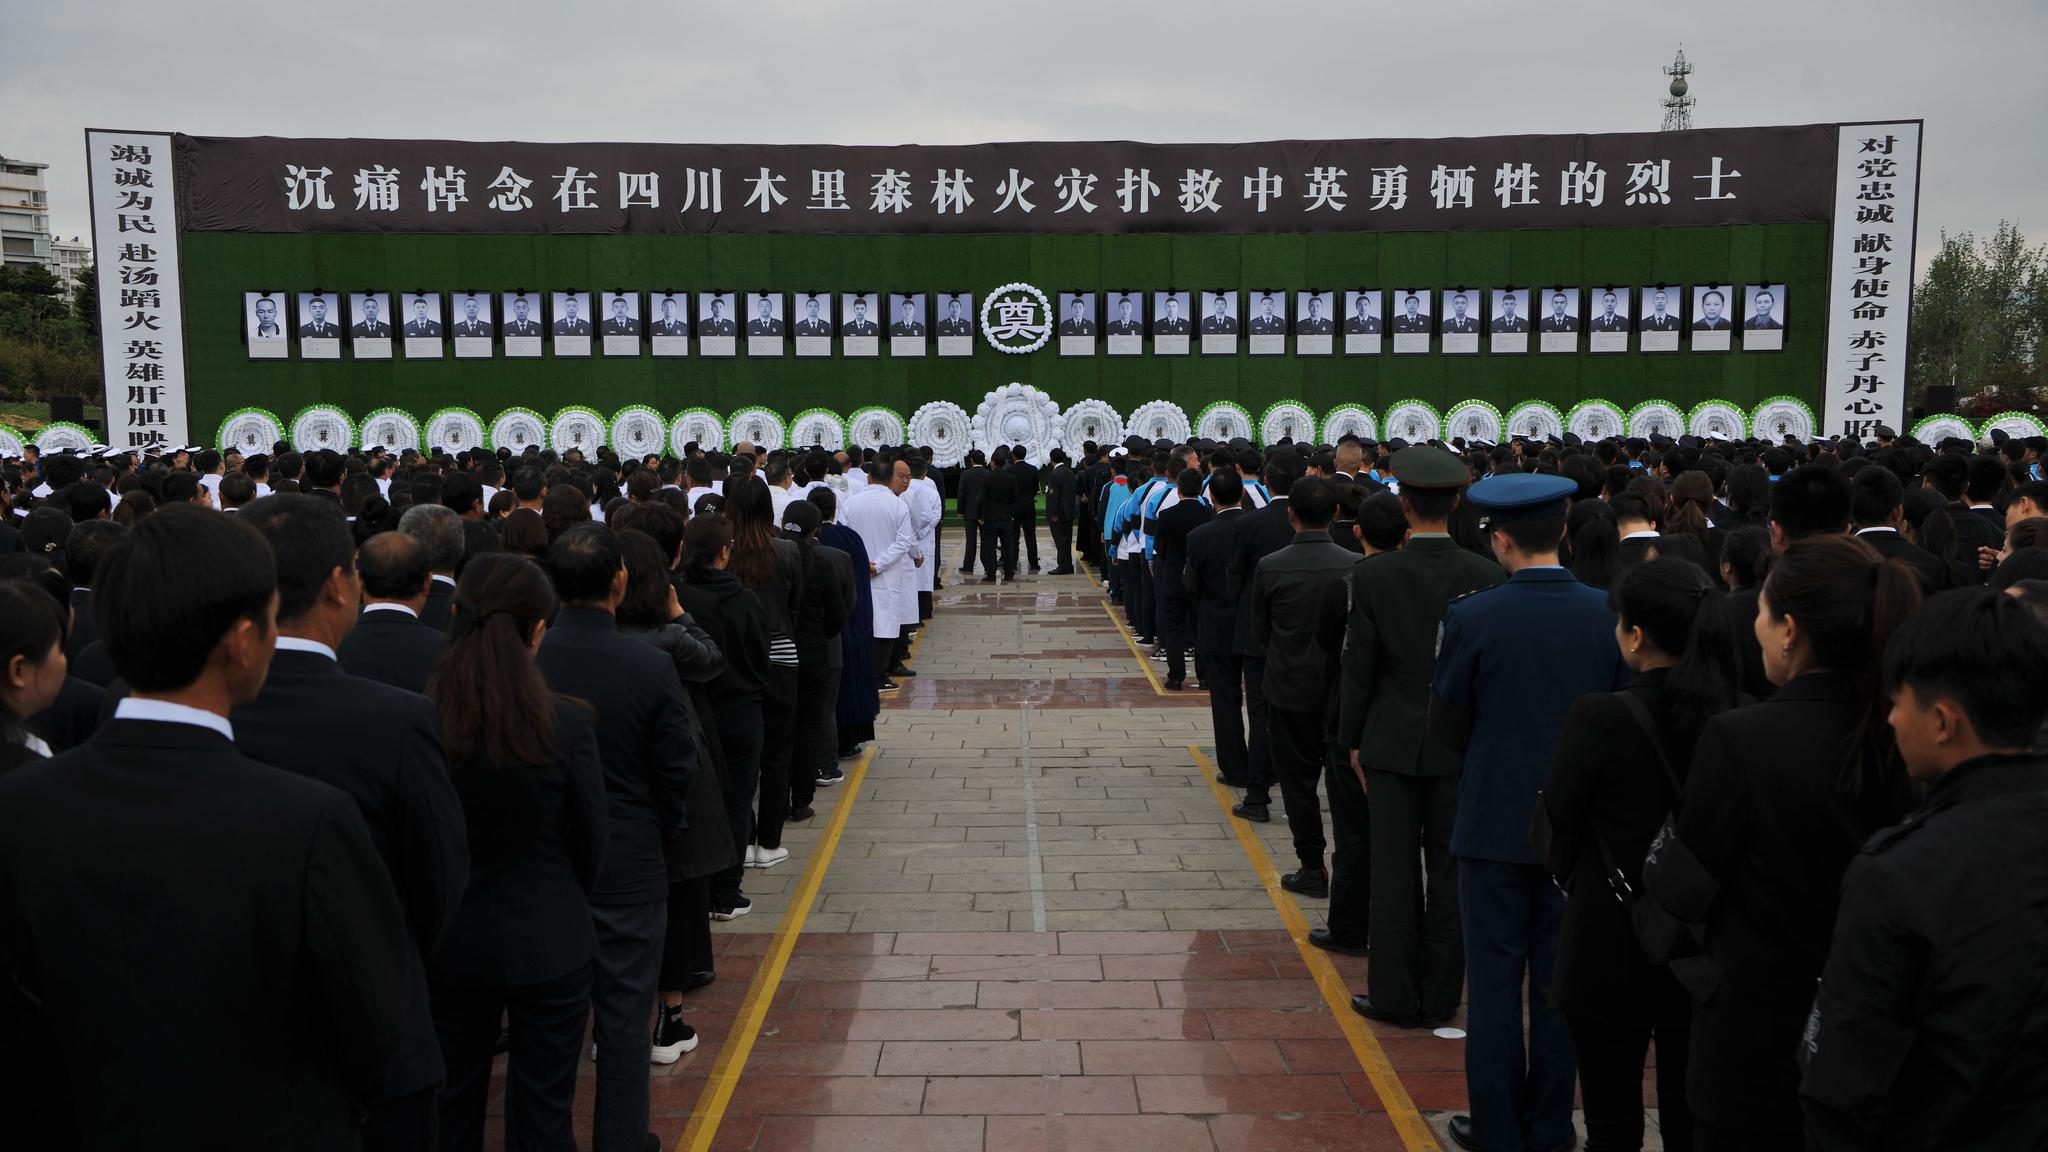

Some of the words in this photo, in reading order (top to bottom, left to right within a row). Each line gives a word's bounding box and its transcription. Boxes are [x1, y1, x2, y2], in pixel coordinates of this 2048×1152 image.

[284, 157, 1742, 214] 沉痛悼念在四川木里森林火灾扑救中英勇牺牲的烈士
[990, 296, 1046, 340] 奠
[123, 339, 169, 449] 英雄肝胆映
